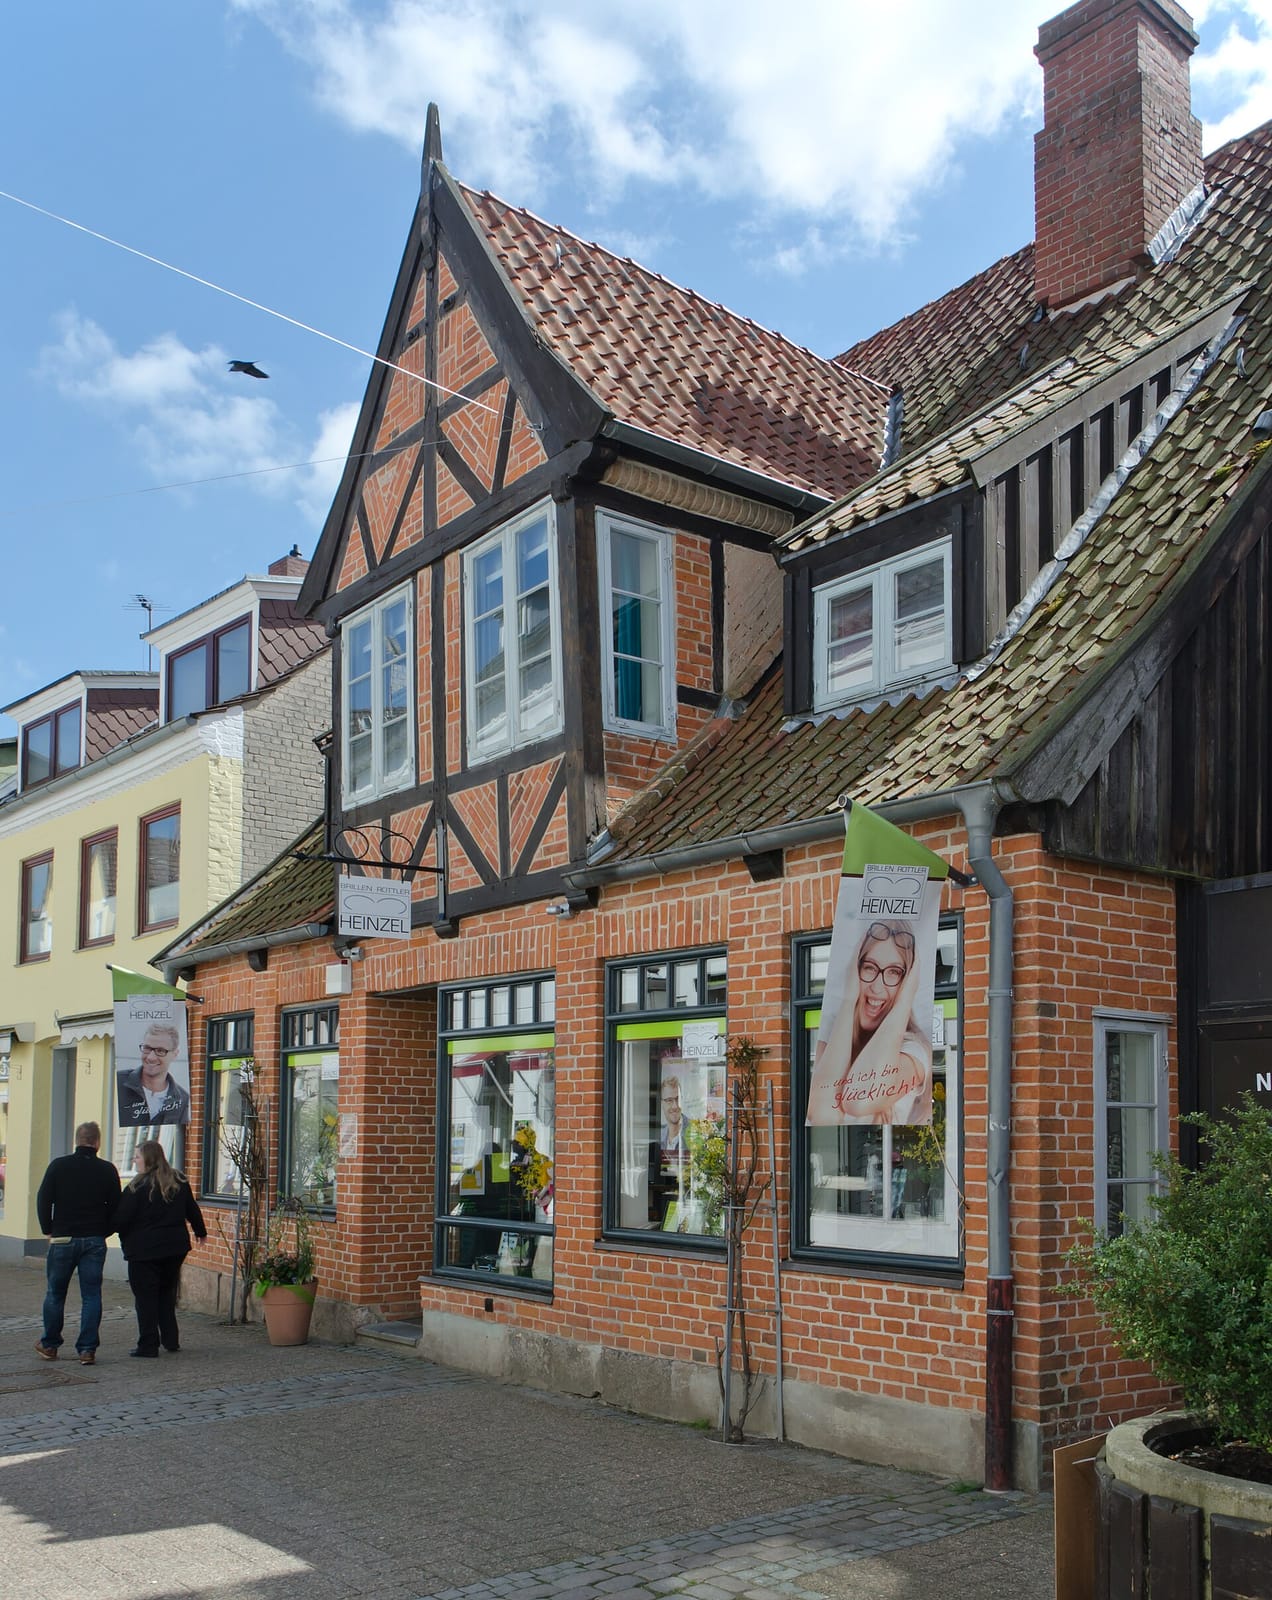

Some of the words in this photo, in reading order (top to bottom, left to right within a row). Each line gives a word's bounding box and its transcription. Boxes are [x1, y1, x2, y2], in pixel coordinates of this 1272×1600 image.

[866, 864, 893, 872] BRILLEN
[340, 883, 372, 891] BRILLEN
[376, 887, 410, 895] ROTTLER
[861, 898, 918, 914] HEINZEL
[340, 914, 409, 933] HEINZEL
[129, 1010, 172, 1019] HEINZEL
[684, 1045, 717, 1056] HEINZEL
[833, 1074, 853, 1087] und
[858, 1069, 877, 1082] ich
[881, 1064, 899, 1077] bin
[832, 1076, 916, 1108] glücklich!
